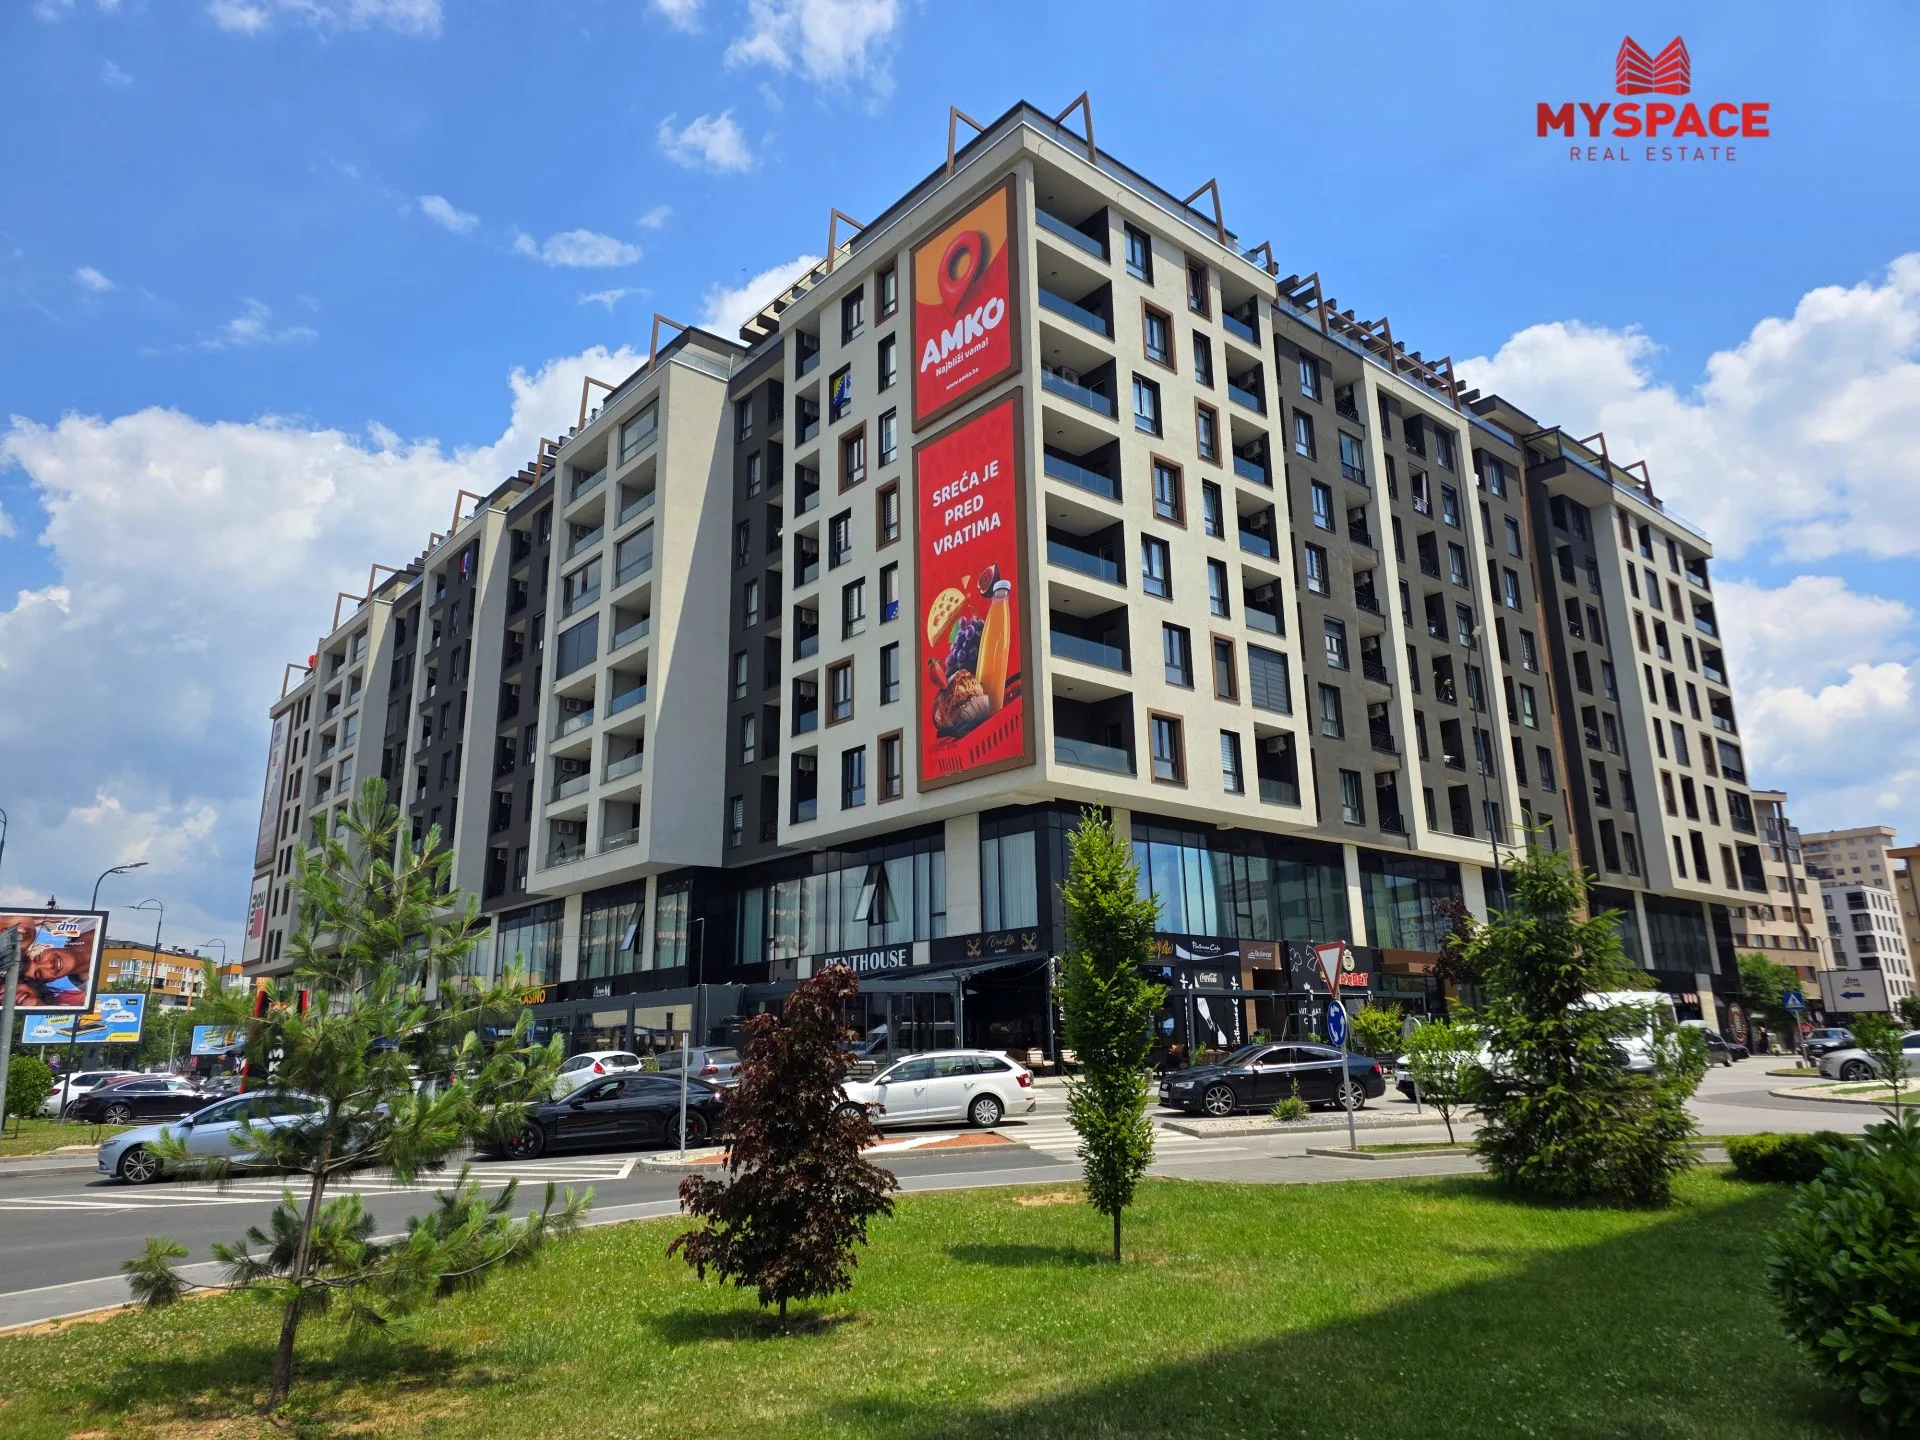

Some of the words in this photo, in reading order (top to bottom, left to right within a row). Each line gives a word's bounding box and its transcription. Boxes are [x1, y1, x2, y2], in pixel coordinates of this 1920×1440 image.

[920, 296, 1005, 373] AMKO
[935, 351, 964, 377] Najbliži
[964, 336, 989, 359] vama!
[932, 470, 980, 508] SREĆA
[982, 459, 999, 483] JE
[944, 494, 984, 527] PRED
[933, 512, 1001, 556] VRATIMA
[520, 988, 546, 1005] ASINO
